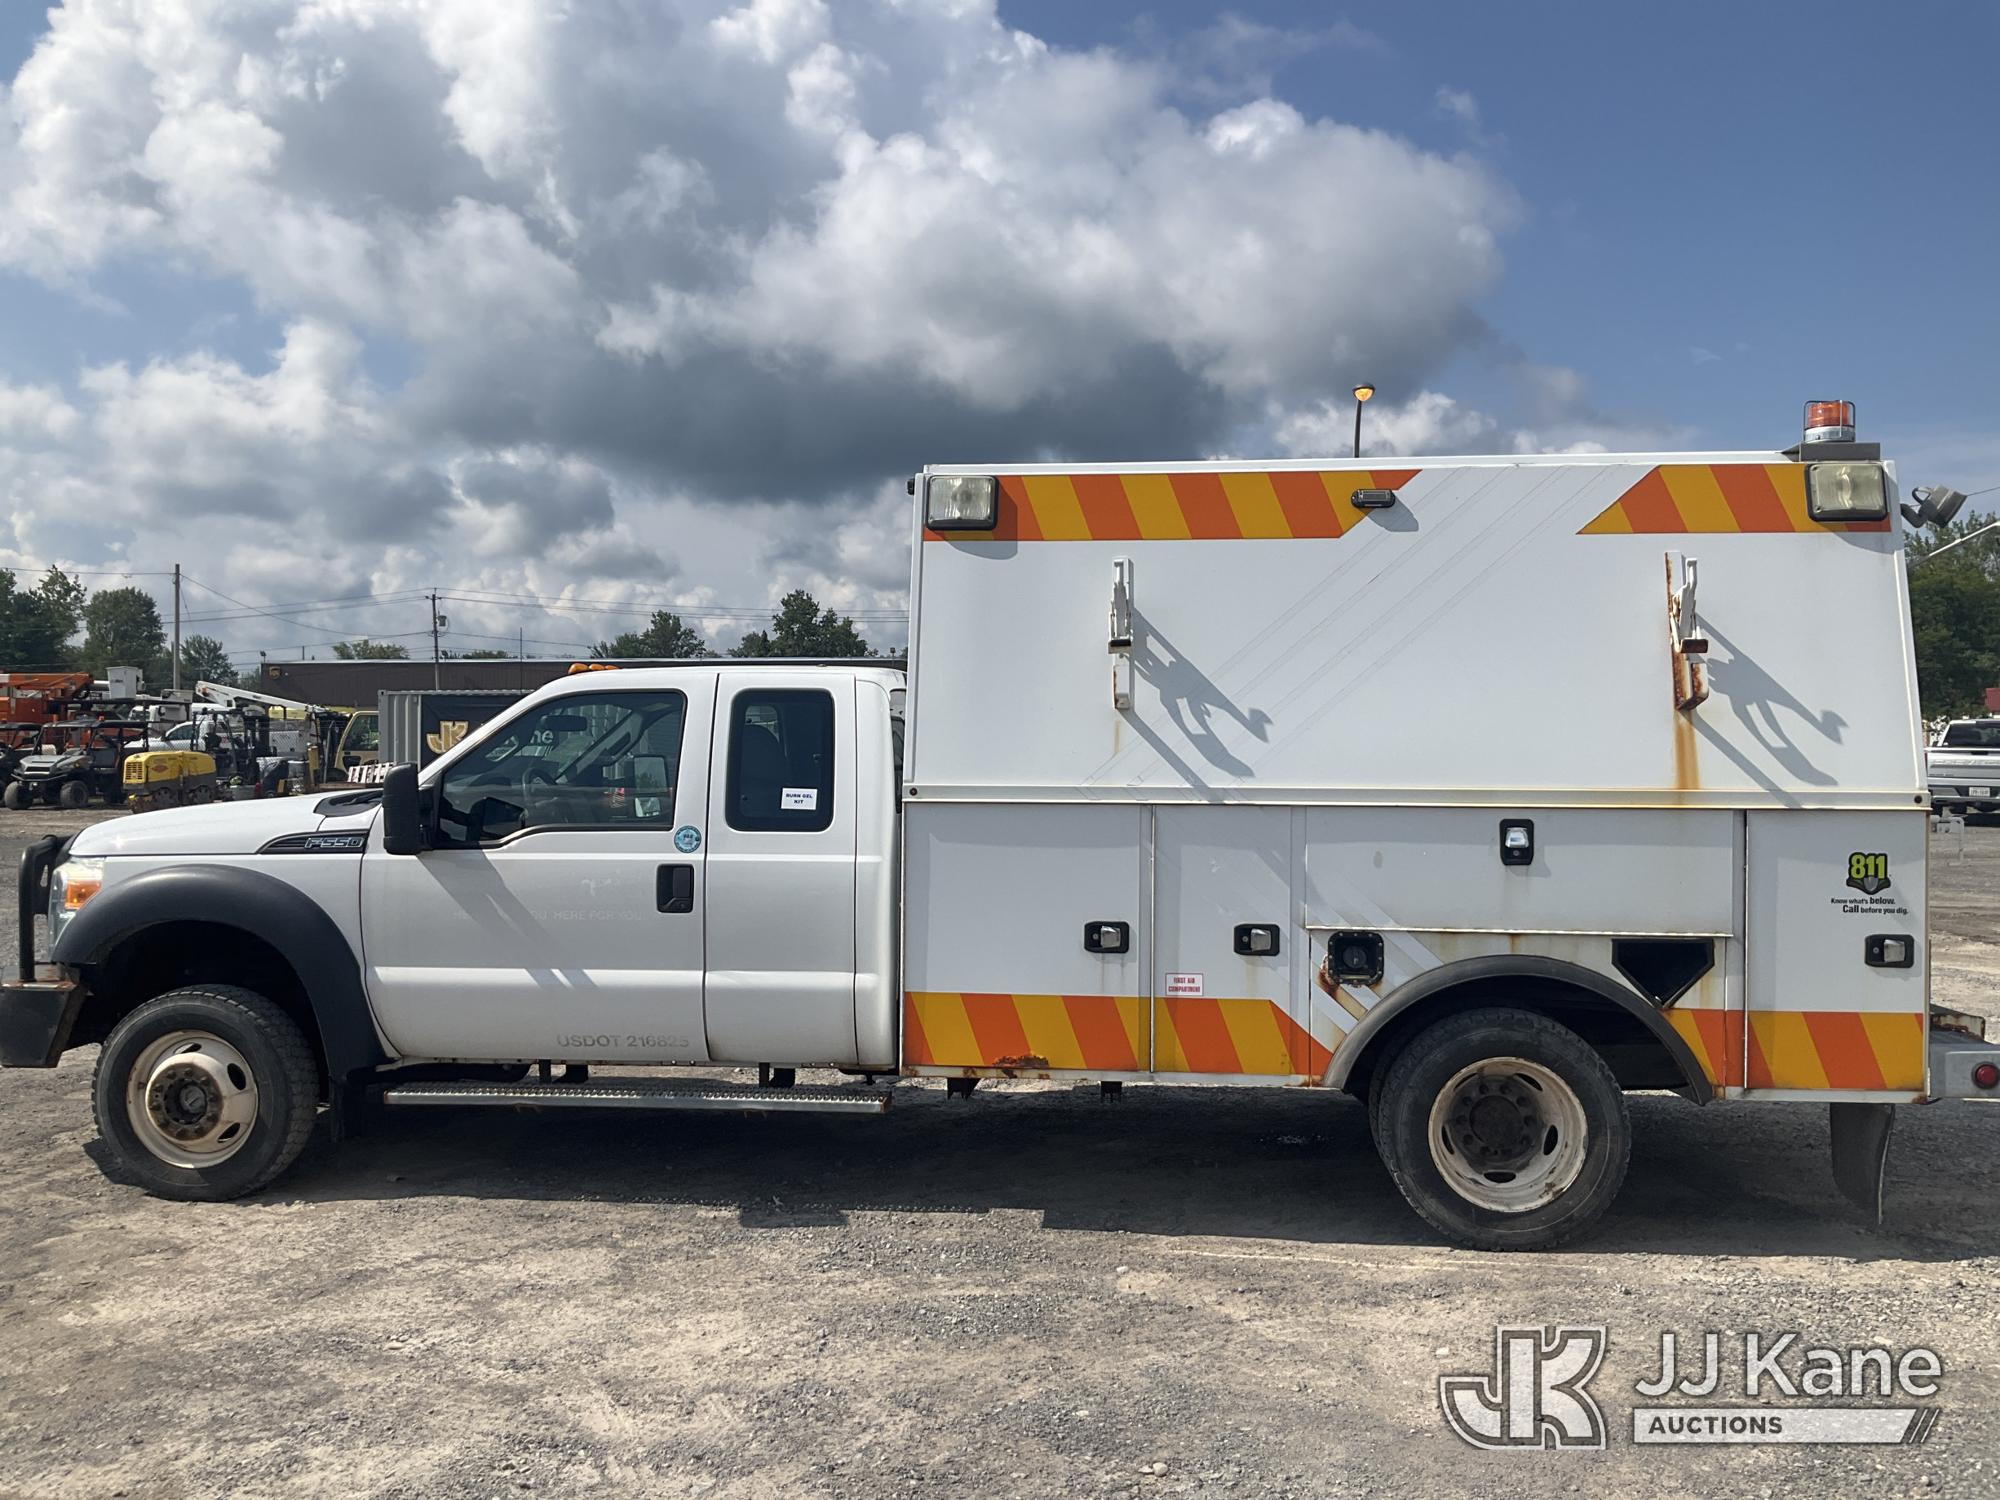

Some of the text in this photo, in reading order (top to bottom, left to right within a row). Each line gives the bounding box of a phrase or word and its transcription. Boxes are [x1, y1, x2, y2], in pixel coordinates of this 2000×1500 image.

[1850, 853, 1886, 879] 811
[1843, 905, 1859, 913] Call
[1860, 906, 1882, 914] before
[557, 1034, 621, 1048] USDOT
